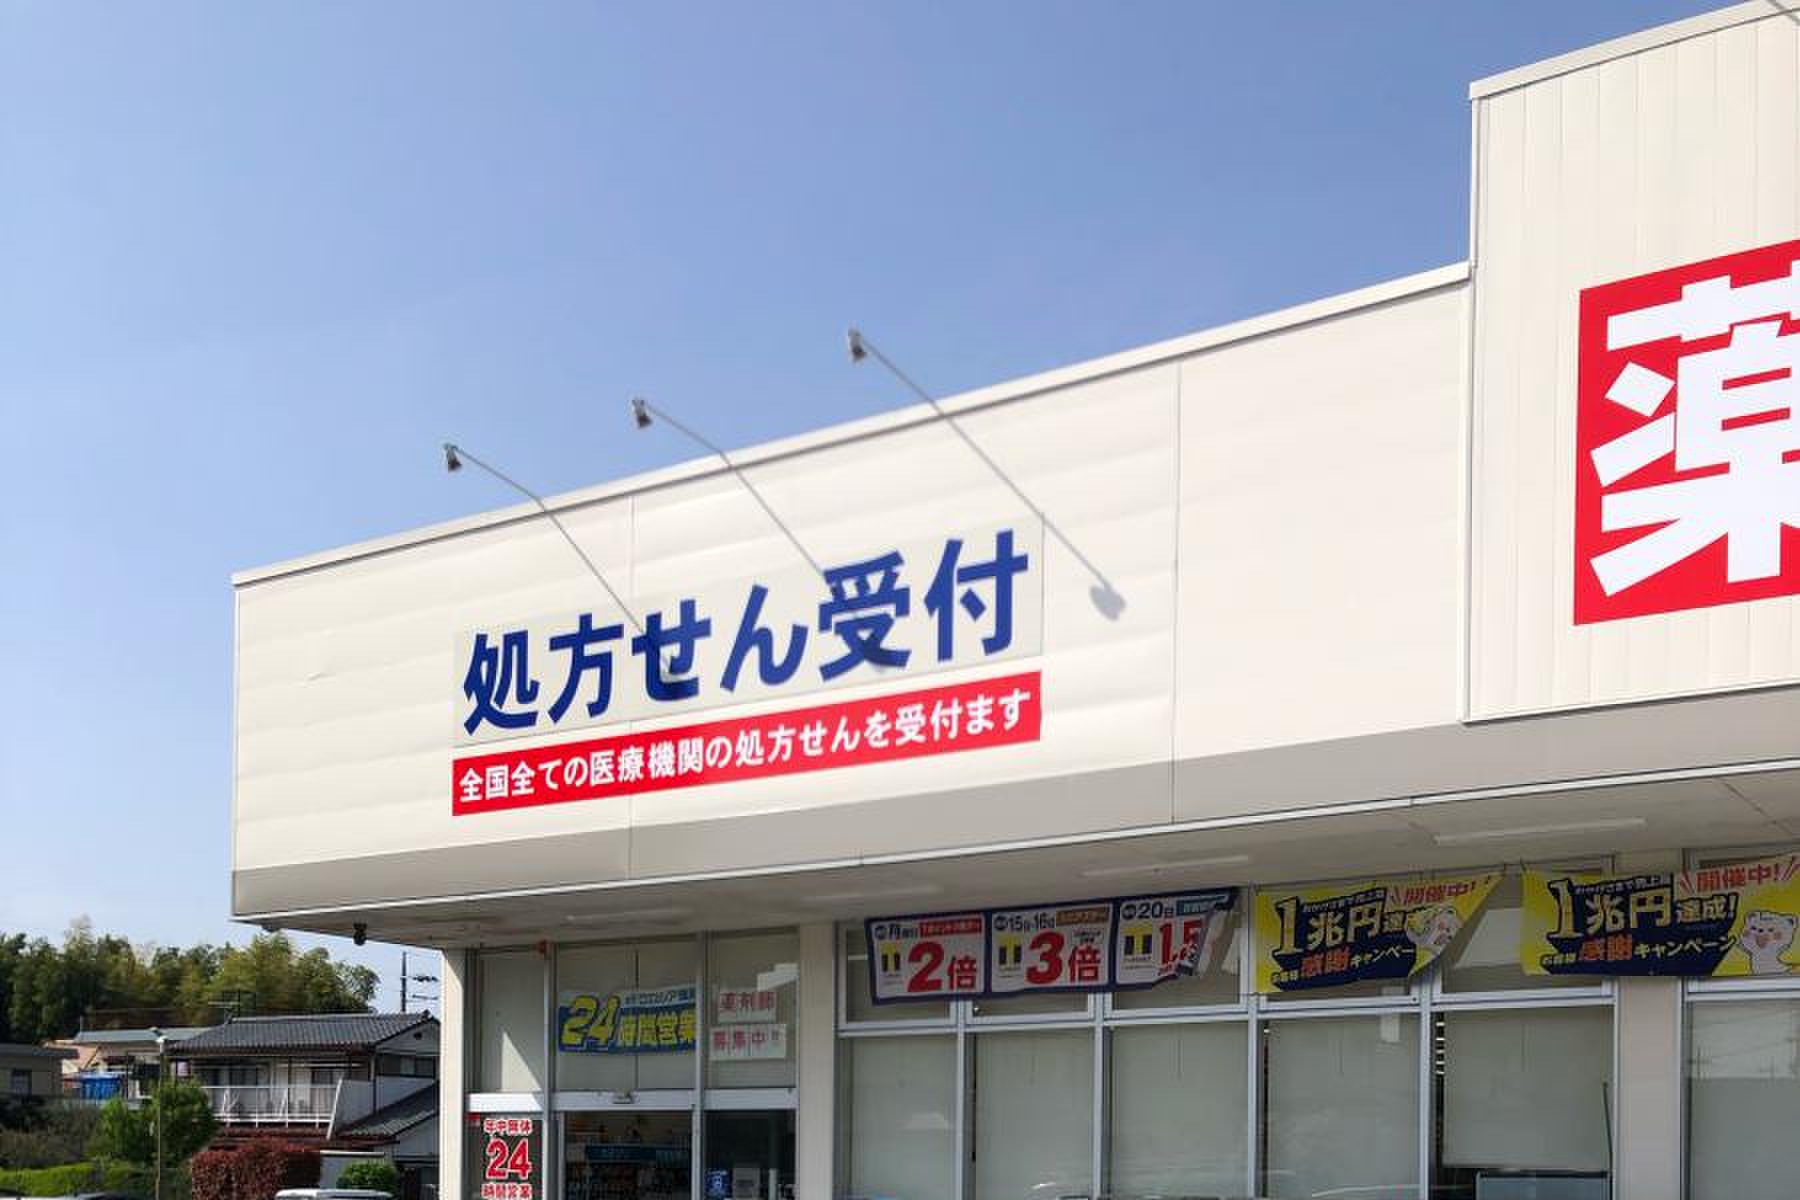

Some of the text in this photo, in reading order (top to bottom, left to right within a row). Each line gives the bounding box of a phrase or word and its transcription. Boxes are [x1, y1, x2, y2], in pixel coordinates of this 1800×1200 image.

[464, 528, 1029, 736] 処方せん受付
[458, 688, 1031, 802] 全国全ての医療機関の処方せんを受付ます
[485, 1138, 532, 1180] 24
